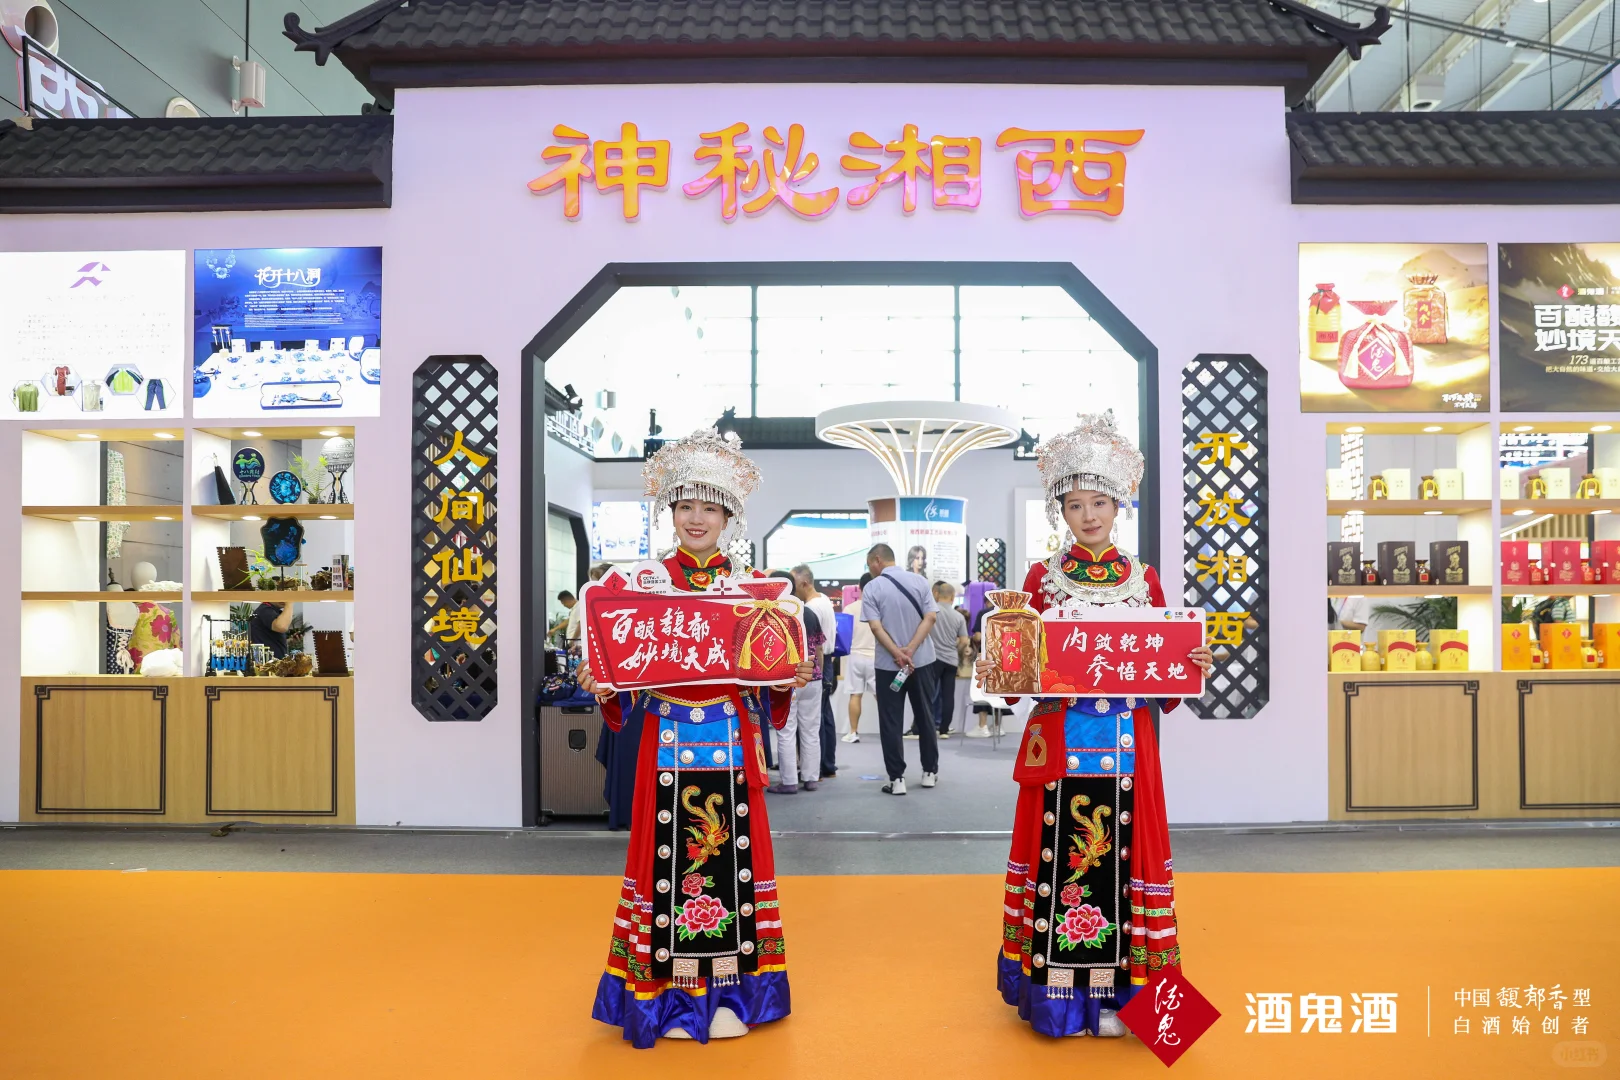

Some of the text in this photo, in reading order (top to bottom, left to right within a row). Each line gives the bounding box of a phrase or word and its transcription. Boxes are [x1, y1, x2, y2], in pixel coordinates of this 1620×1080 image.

[527, 121, 1146, 222] 神秘湘西
[254, 266, 321, 288] 花开十八洞
[1370, 344, 1384, 372] 酒鬼
[432, 430, 489, 645] 人间仙境
[1193, 432, 1251, 646] 开放湘西
[601, 606, 710, 645] 百酿馥郁
[1062, 626, 1164, 653] 内敛乾坤
[618, 636, 730, 679] 妙境天成
[762, 632, 776, 662] 酒鬼
[1006, 637, 1018, 664] 内参
[1086, 654, 1188, 686] 参悟天地
